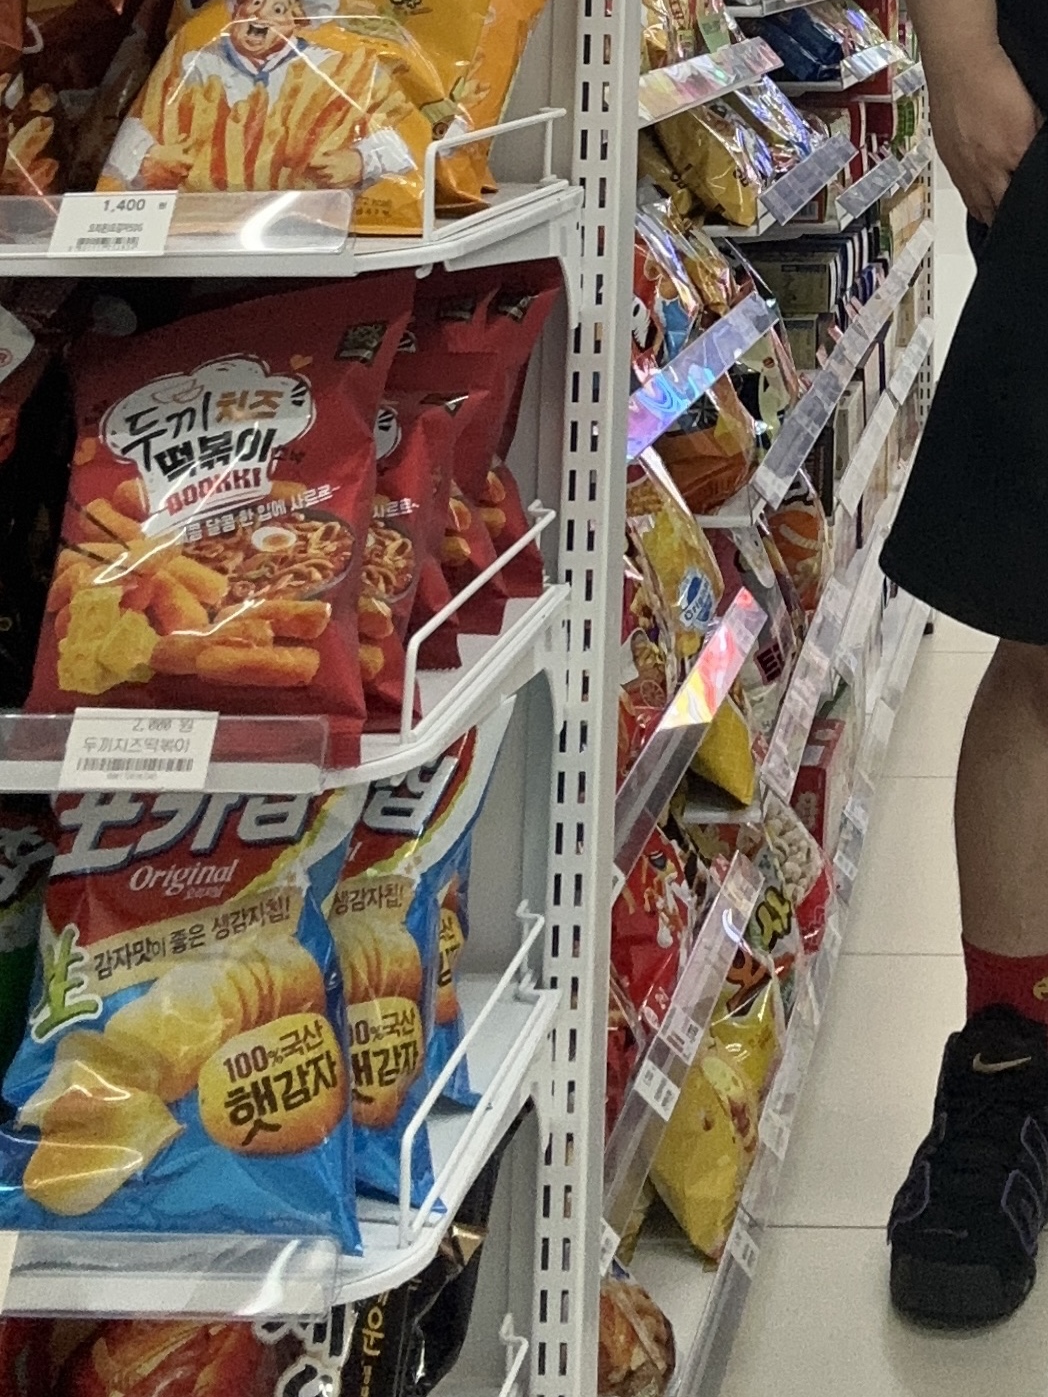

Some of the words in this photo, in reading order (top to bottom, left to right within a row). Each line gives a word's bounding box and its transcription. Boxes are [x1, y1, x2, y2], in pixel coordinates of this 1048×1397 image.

[102, 199, 145, 212] 1,400
[121, 392, 212, 472] 두끼
[215, 390, 284, 423] 치즈
[154, 428, 277, 482] 떡볶이
[165, 467, 262, 516] DOOKKI
[206, 513, 236, 536] 달콤
[257, 501, 287, 522] 입에
[129, 859, 240, 896] Original
[93, 937, 167, 981] 감자맛이
[169, 923, 206, 955] 좋은
[211, 896, 291, 941] 생감자칩!
[224, 1050, 338, 1146] 햇감자
